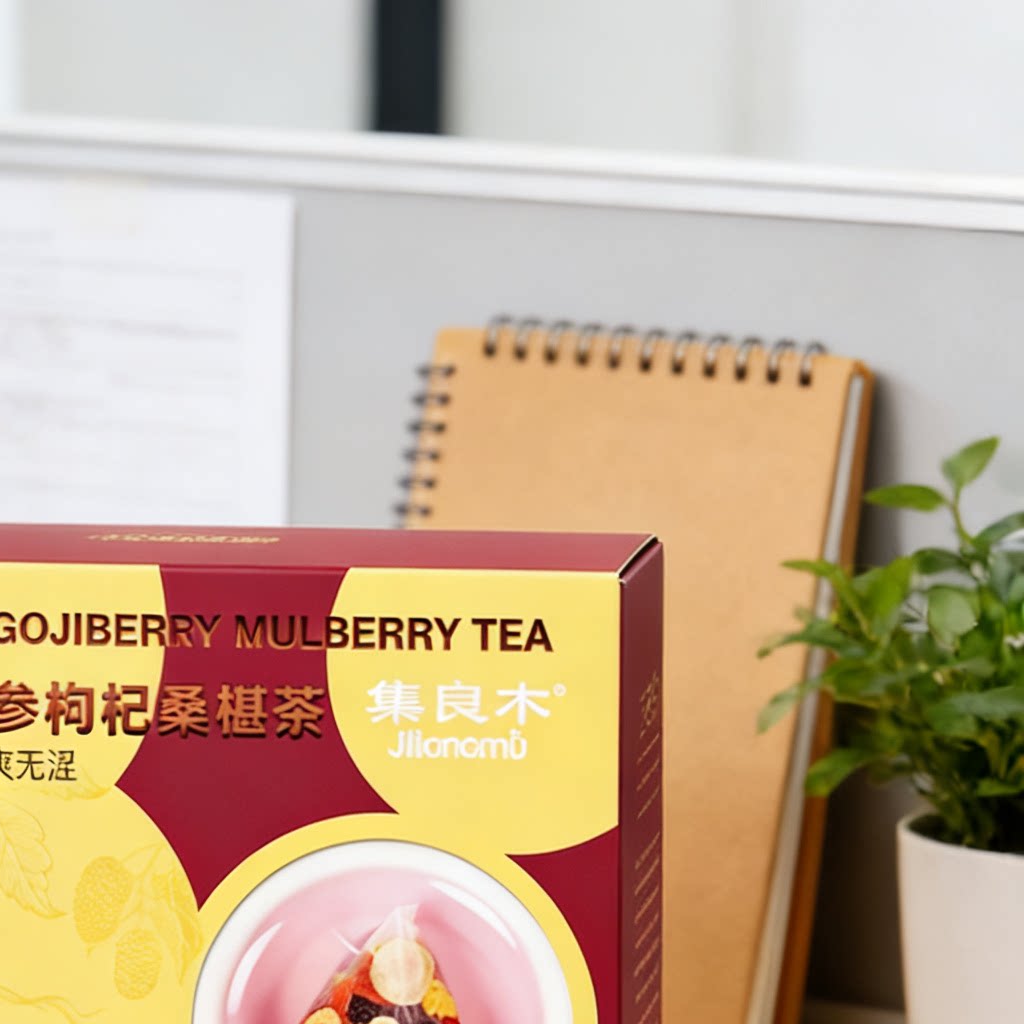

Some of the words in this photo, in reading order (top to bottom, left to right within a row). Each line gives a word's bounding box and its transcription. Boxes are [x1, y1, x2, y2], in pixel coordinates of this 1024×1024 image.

[235, 615, 462, 652] MULBERRY
[471, 617, 553, 653] TEA
[365, 679, 551, 726] 集良木
